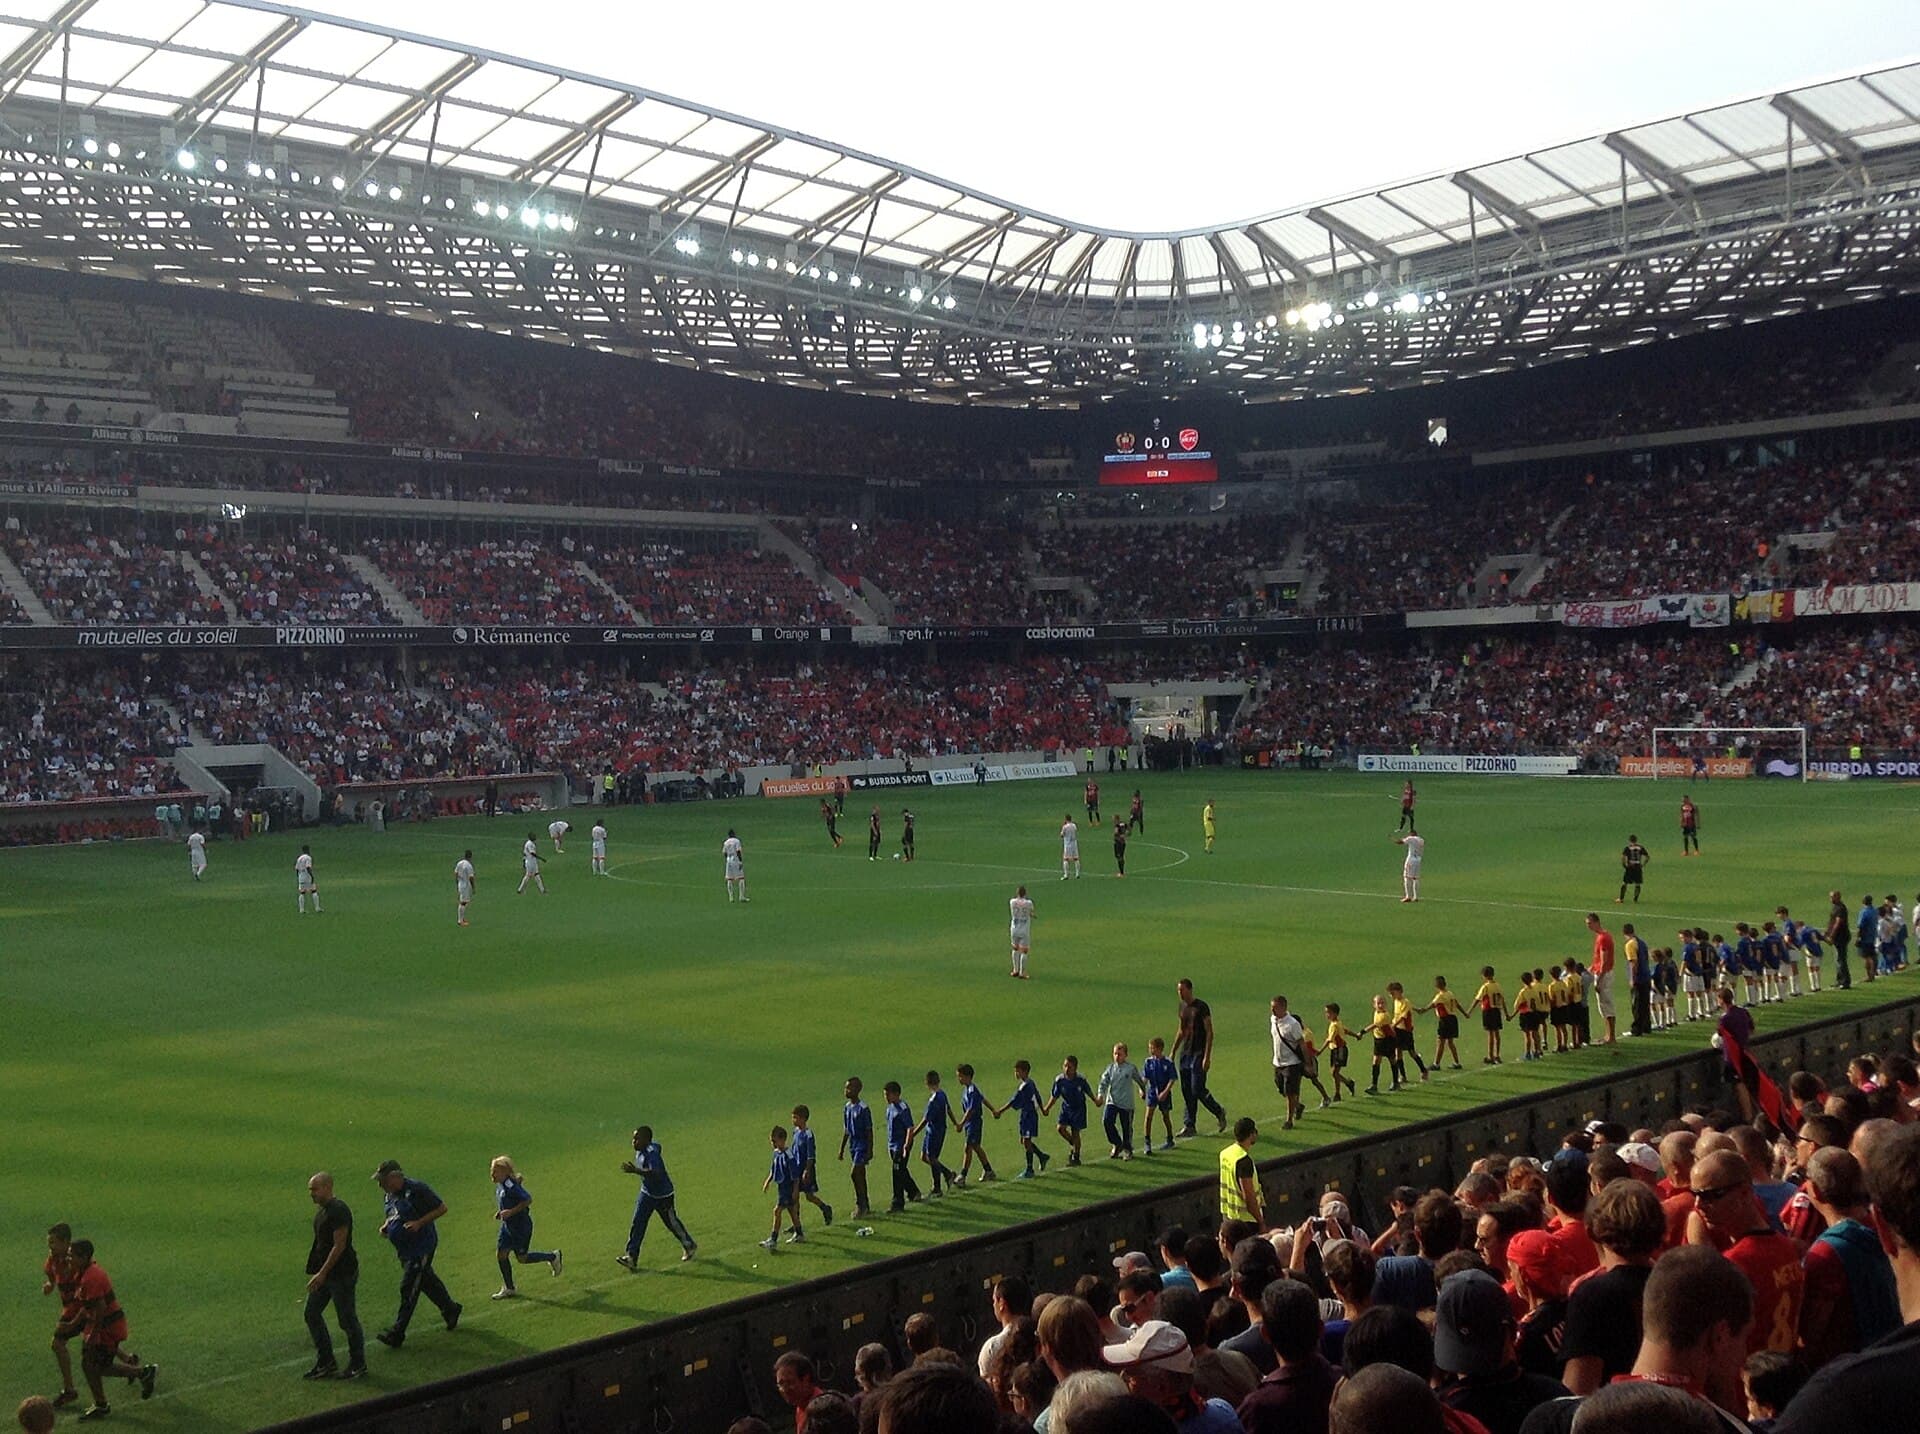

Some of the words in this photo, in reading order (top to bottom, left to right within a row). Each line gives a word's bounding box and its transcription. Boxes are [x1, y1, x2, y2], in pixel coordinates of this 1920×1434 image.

[92, 430, 127, 440] Allianz
[146, 432, 179, 443] Riviera
[1145, 437, 1153, 449] 0
[1162, 436, 1170, 449] 0
[88, 485, 129, 496] Riviera
[78, 629, 163, 645] mutuelles
[168, 629, 191, 644] du
[196, 628, 238, 644] soleil
[276, 628, 345, 644] PIZZORNO
[474, 628, 570, 644] Rémanence
[774, 627, 810, 641] Orange
[1026, 626, 1095, 639] castorama
[1466, 758, 1517, 771] PIZZORNO
[1876, 762, 1920, 776] SPOR
[869, 776, 901, 786] BURRDA
[903, 774, 928, 784] SPORT
[766, 783, 810, 795] mutuelles
[812, 781, 825, 792] du
